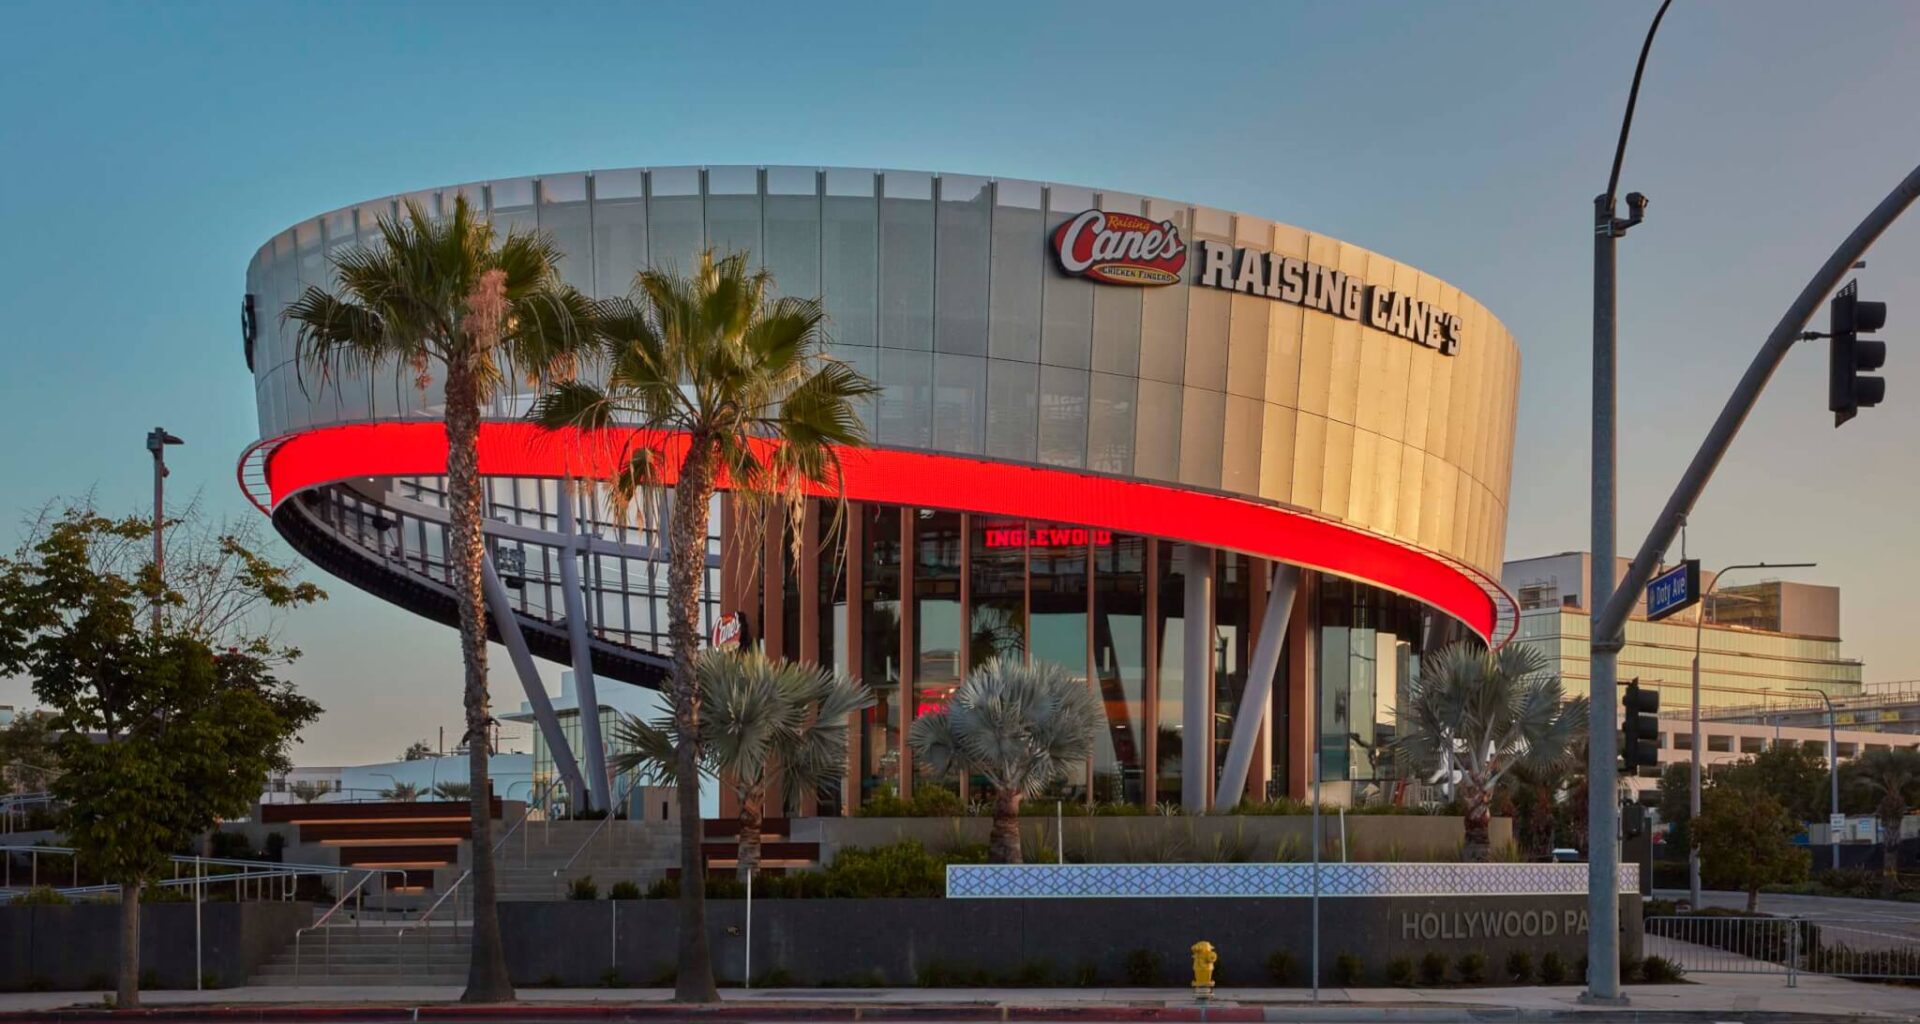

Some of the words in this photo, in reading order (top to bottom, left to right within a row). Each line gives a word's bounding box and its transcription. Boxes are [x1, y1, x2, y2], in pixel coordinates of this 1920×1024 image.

[1107, 214, 1151, 233] Raising
[1061, 209, 1184, 272] Cane's
[1102, 266, 1136, 278] CHICKEN
[1138, 271, 1172, 282] FINGERS
[1200, 240, 1364, 321] RAISING
[1371, 284, 1463, 357] CANE'S
[1656, 583, 1671, 606] Doty
[1673, 577, 1686, 598] Ave
[1402, 910, 1557, 940] HOLLYWOOD
